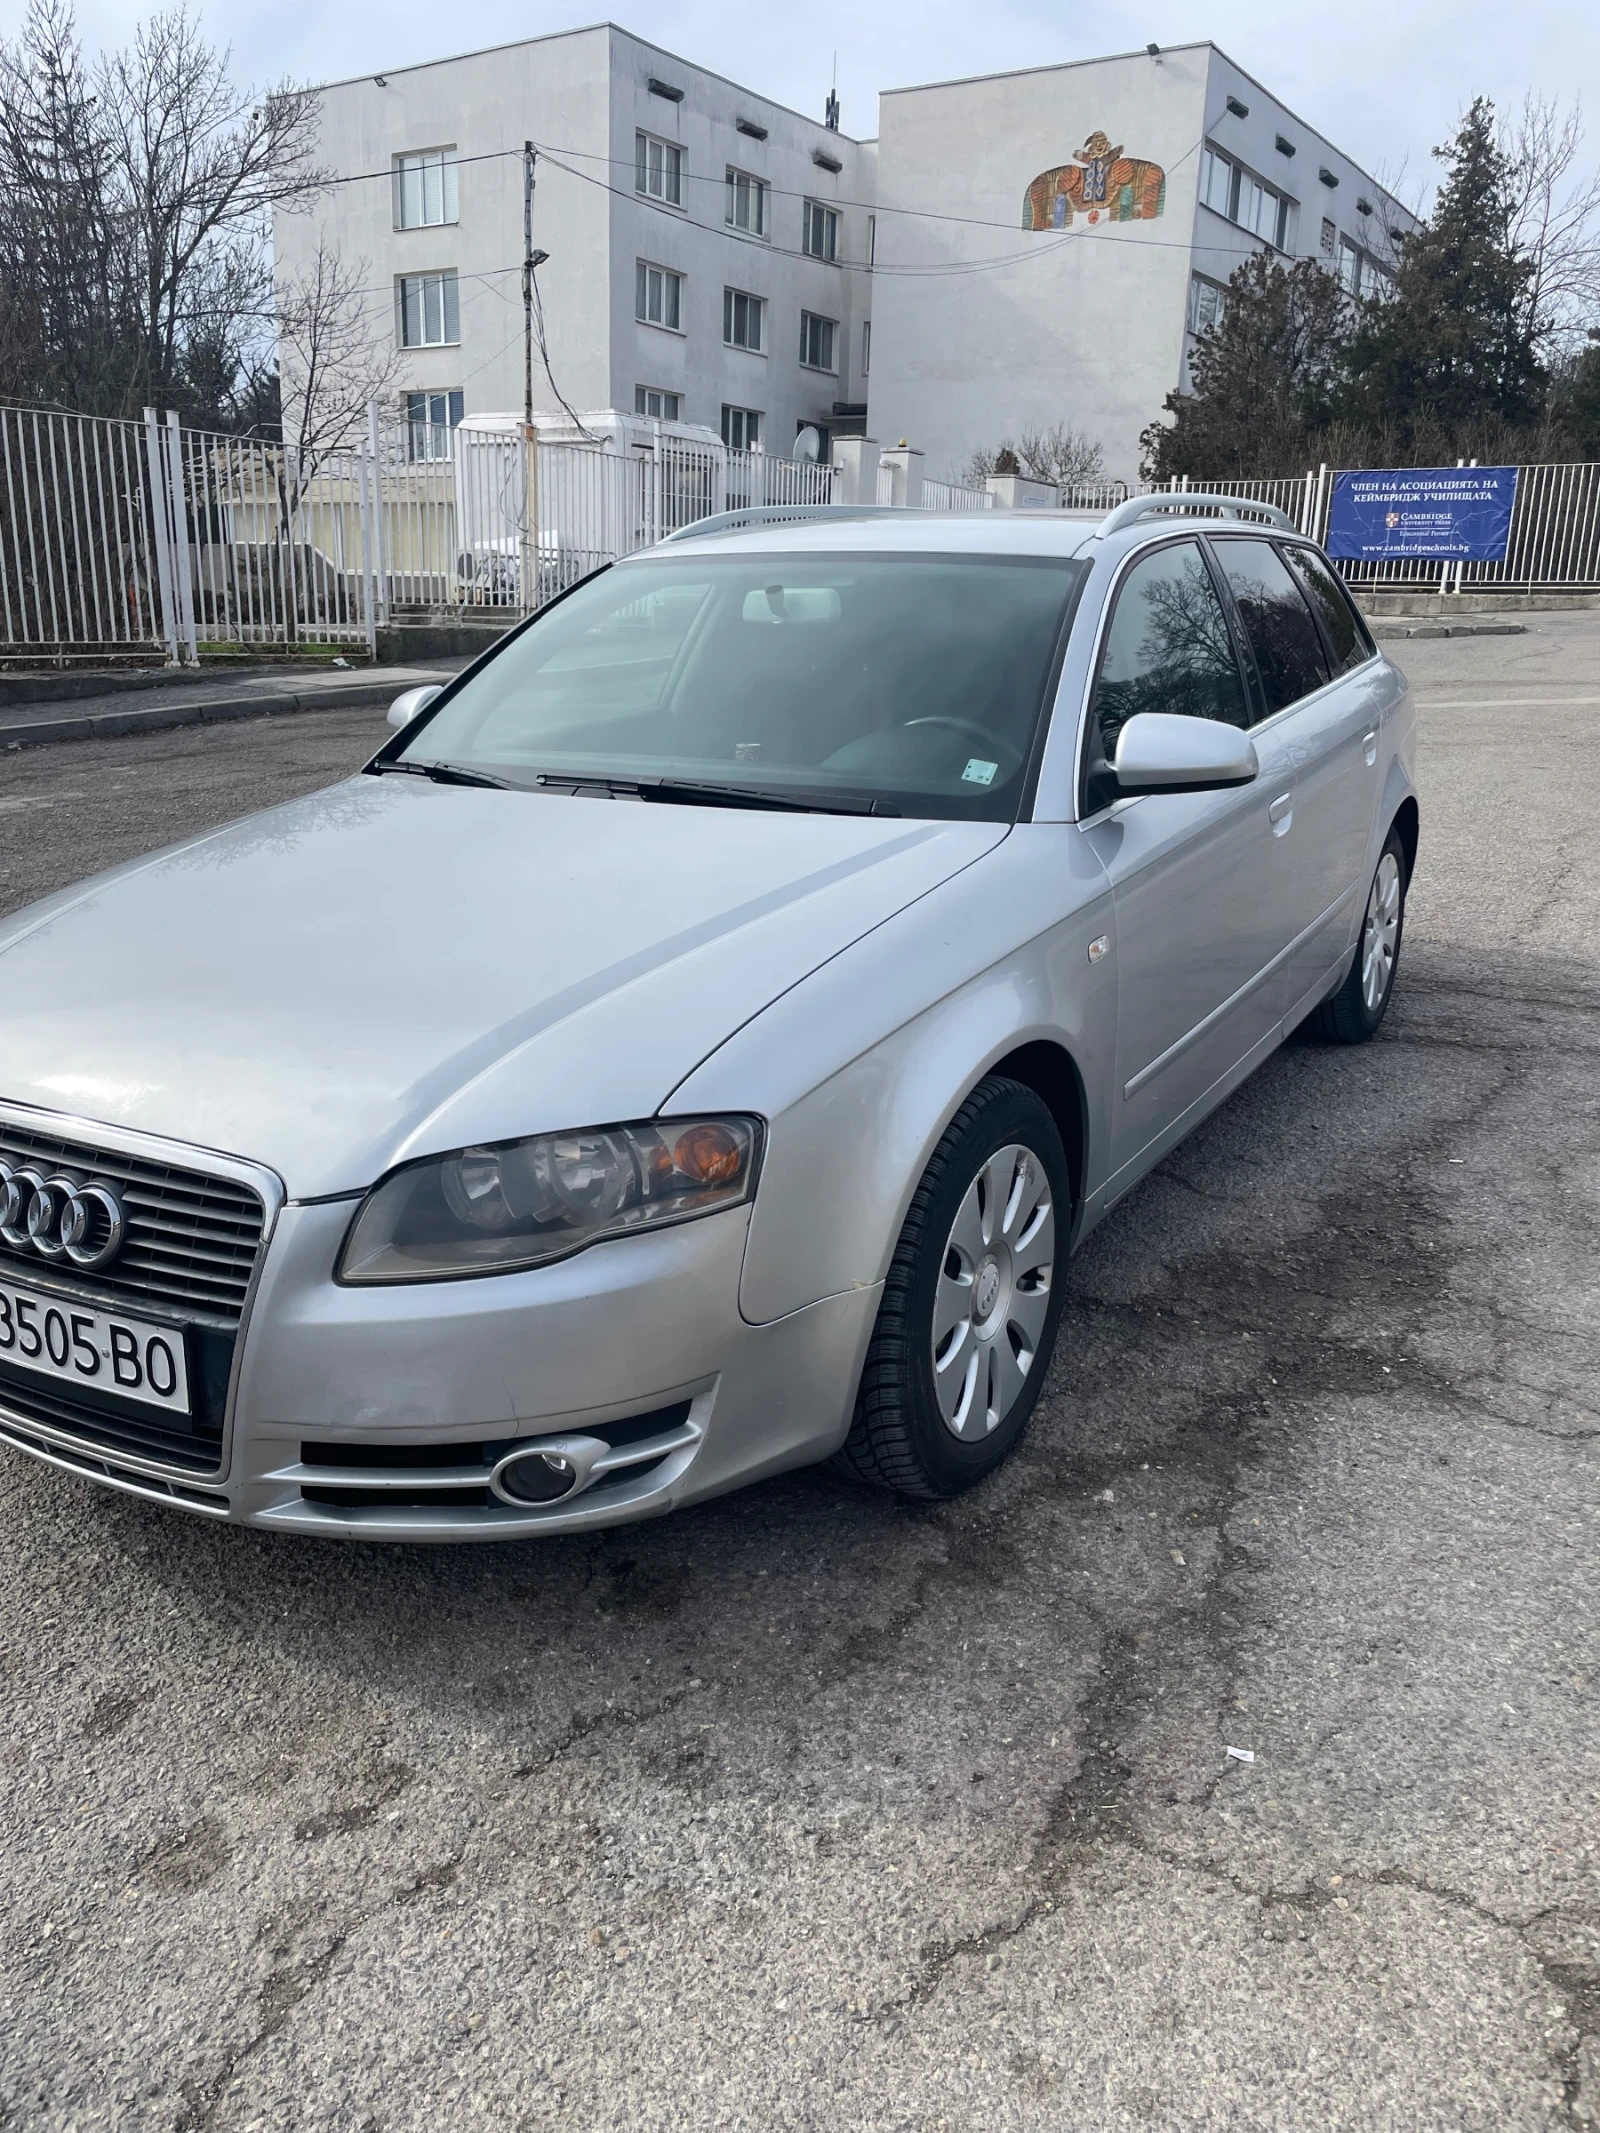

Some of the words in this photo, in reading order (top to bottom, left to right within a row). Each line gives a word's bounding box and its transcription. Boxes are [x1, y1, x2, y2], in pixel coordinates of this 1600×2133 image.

[1351, 482, 1379, 491] ЧЛЕН
[1381, 482, 1397, 491] НА
[1399, 480, 1480, 491] АСОЦИАЦИЯТА
[1482, 480, 1498, 488] НА
[1353, 492, 1421, 502] КЕЙМБРИДЖ
[1423, 492, 1492, 501] УЧИЛИЩАТА
[1362, 543, 1470, 553] www.cambridgeschools.bg
